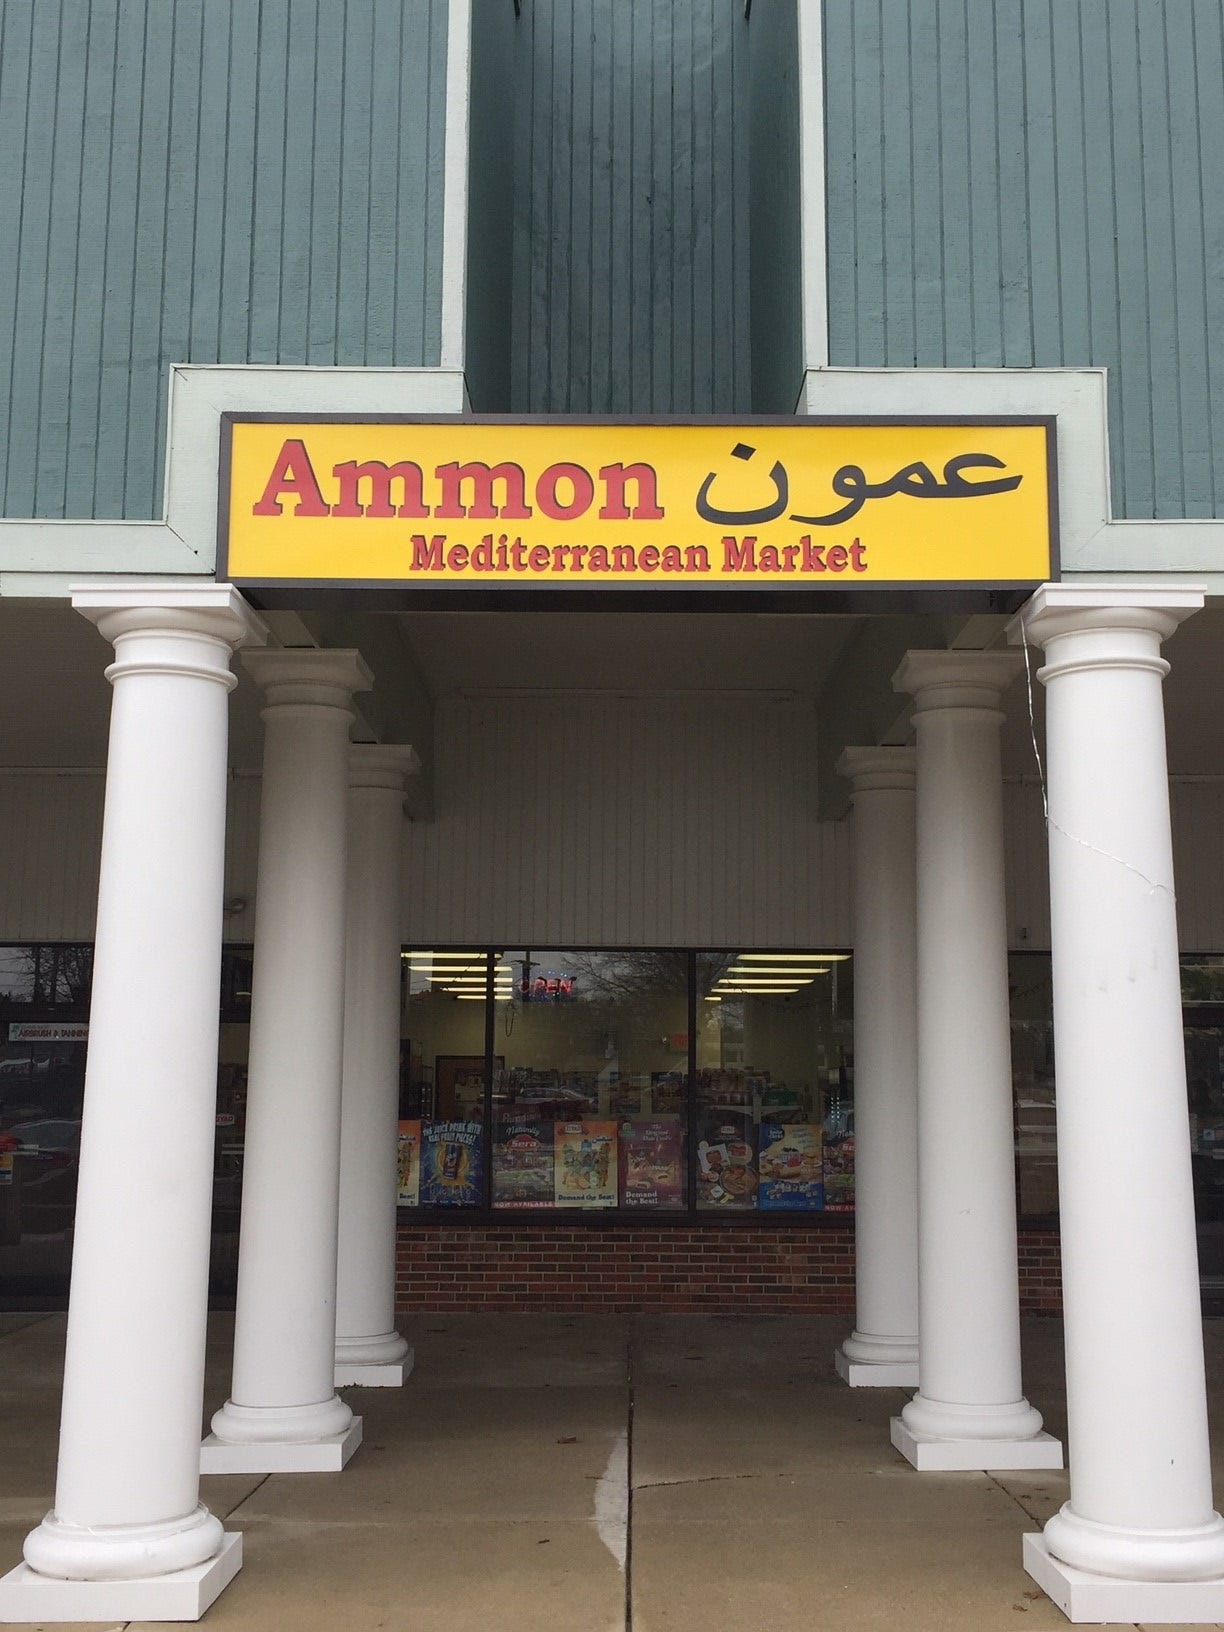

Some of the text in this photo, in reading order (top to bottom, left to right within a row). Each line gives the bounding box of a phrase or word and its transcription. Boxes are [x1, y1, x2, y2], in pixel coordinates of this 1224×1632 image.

[252, 438, 665, 521] Ammon
[695, 443, 1023, 526] عمون
[410, 535, 868, 573] Mediterranean Market
[625, 1190, 658, 1198] Demand
